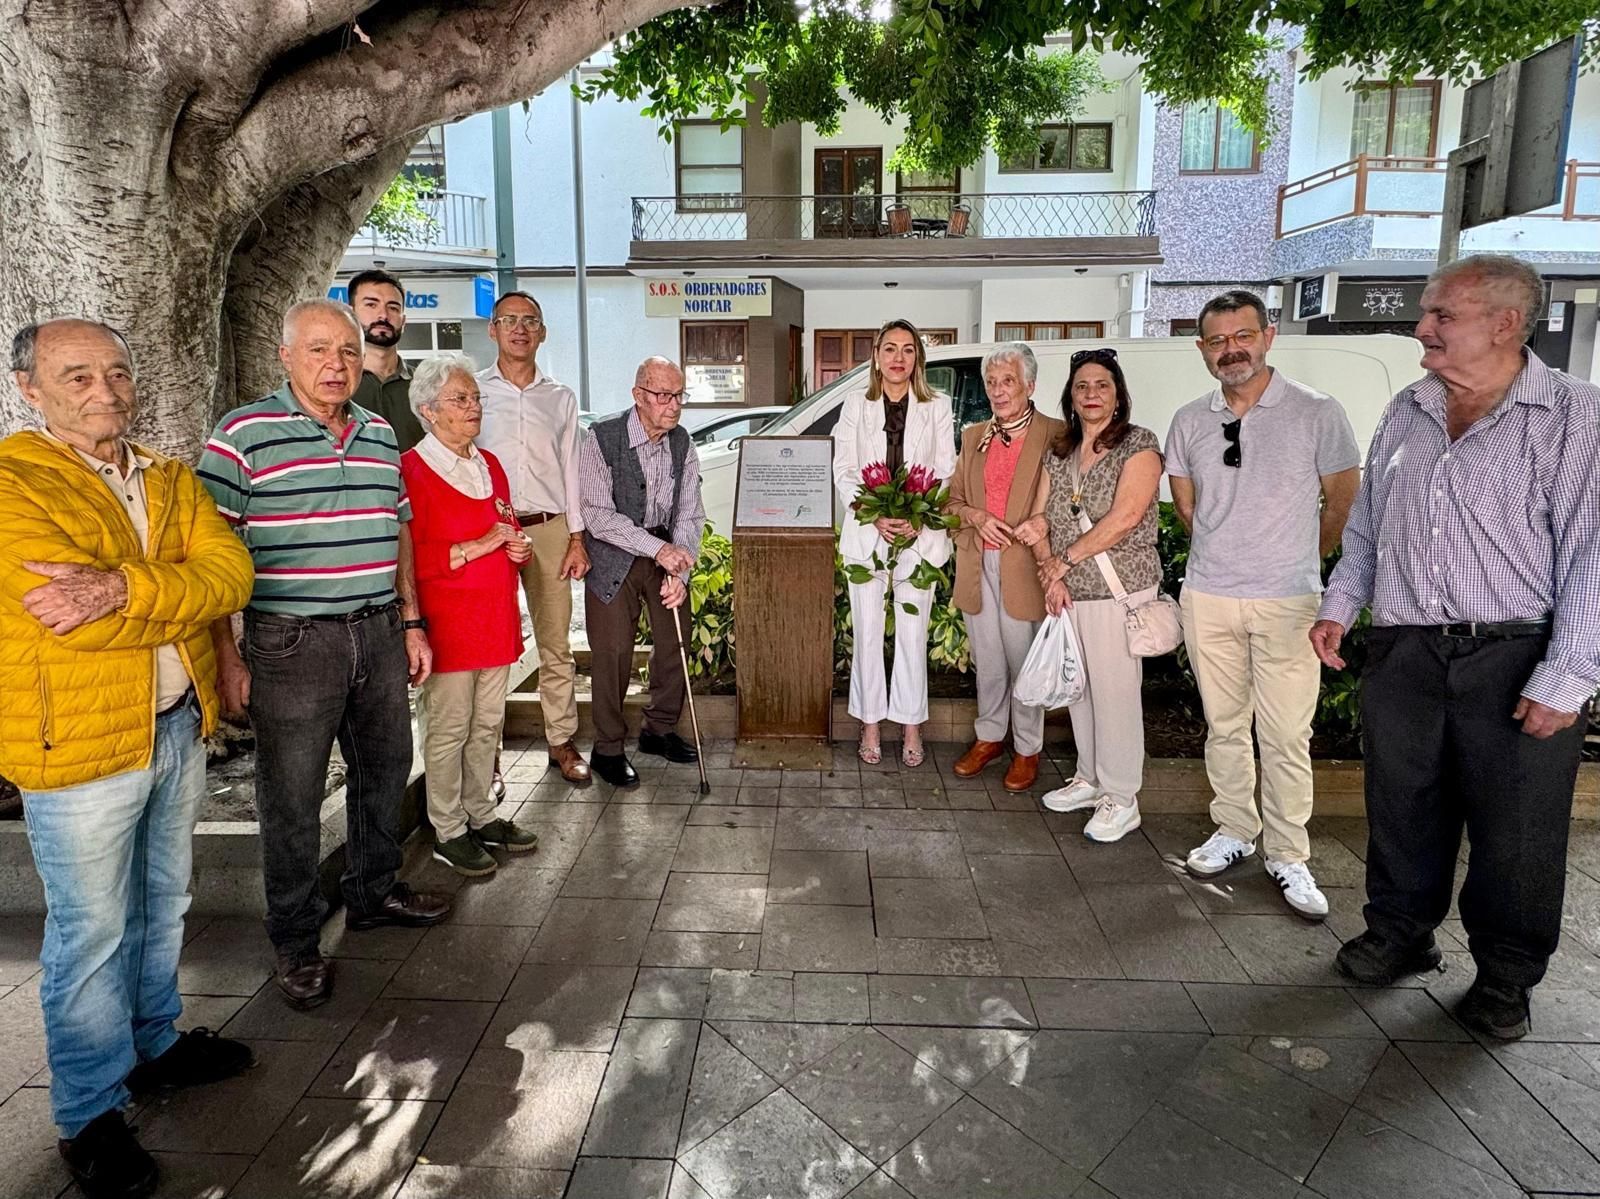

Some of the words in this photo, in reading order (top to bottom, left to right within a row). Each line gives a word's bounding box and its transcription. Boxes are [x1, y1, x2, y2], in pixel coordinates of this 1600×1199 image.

[649, 282, 681, 296] S.O.S.
[684, 282, 767, 296] ORDENADORES
[406, 291, 438, 308] tas
[684, 299, 732, 313] NORCAR
